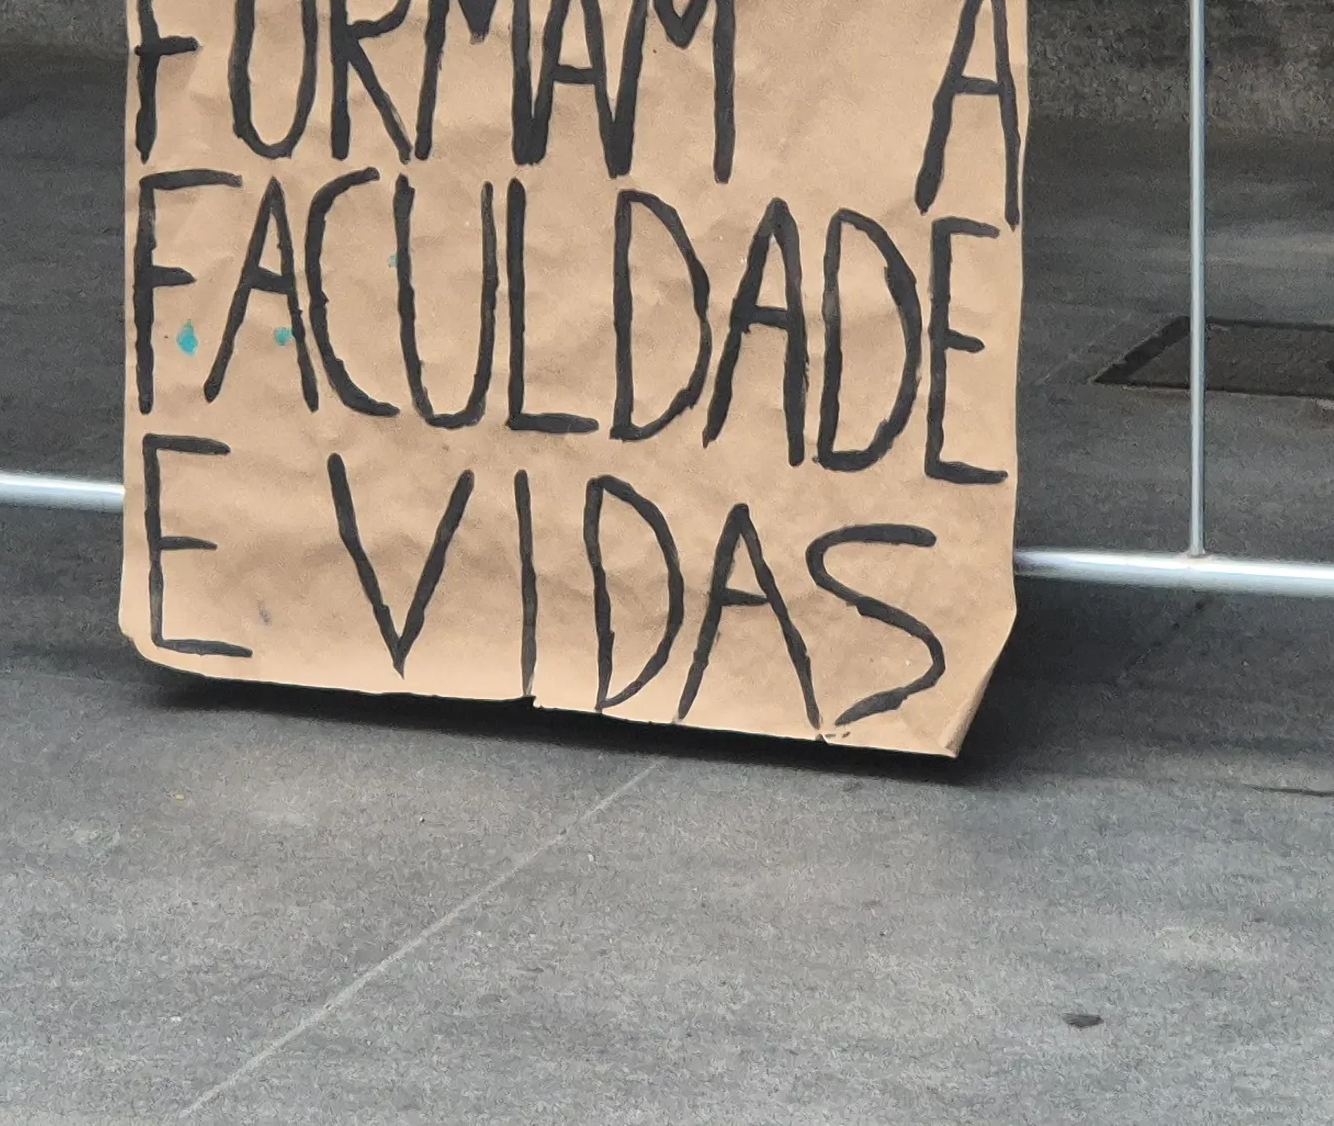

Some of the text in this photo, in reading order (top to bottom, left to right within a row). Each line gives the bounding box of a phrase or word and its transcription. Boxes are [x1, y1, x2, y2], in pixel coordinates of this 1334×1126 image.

[133, 168, 1009, 486] FACULDADE
[141, 433, 947, 732] E VIDAS
